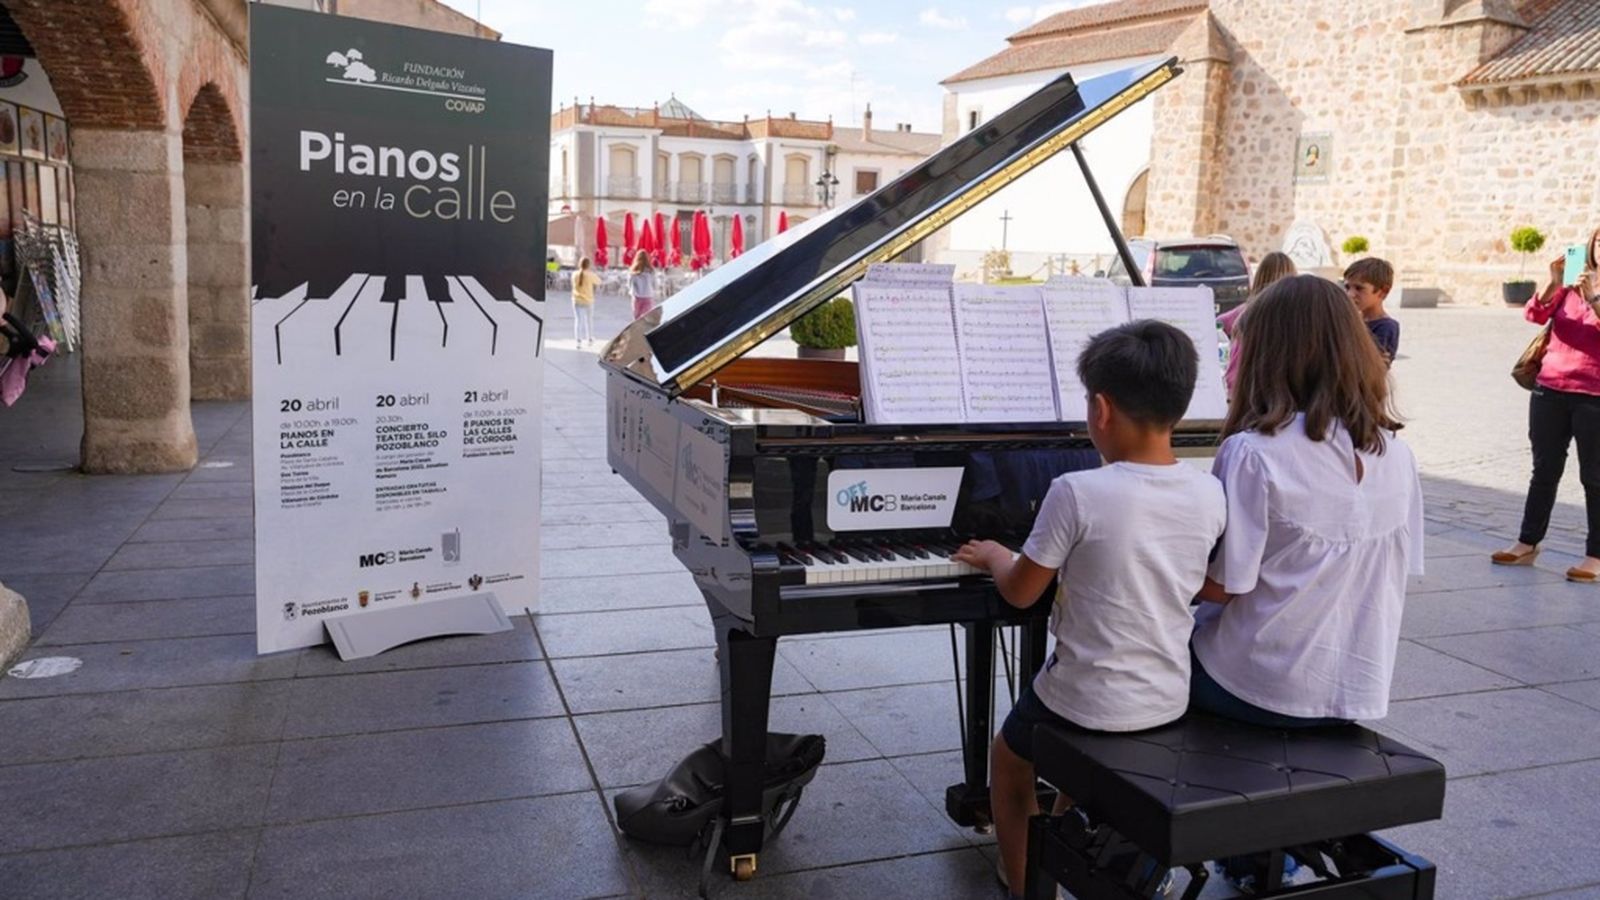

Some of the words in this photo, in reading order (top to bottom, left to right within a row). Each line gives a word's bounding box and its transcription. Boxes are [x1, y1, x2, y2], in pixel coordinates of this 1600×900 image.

[403, 62, 465, 79] FUNDACIÓN
[382, 72, 415, 85] Ricardo
[416, 77, 450, 91] Delgado
[445, 99, 486, 113] COVAP
[300, 130, 461, 182] Pianos
[332, 189, 366, 209] en
[374, 186, 396, 210] la
[403, 144, 517, 223] calle
[376, 394, 396, 408] 20
[399, 392, 430, 407] abril
[464, 391, 478, 403] 21
[481, 389, 509, 403] abril
[280, 399, 302, 412] 20
[306, 396, 340, 411] abril
[375, 423, 429, 434] CONCIERTO
[470, 418, 502, 427] PIANOS
[503, 418, 515, 426] EN
[280, 429, 319, 440] PIANOS
[321, 428, 335, 438] EN
[375, 432, 413, 443] TEATRO
[414, 431, 426, 440] EL
[427, 430, 448, 439] SILO
[464, 428, 479, 436] LAS
[481, 426, 512, 435] CALLES
[280, 441, 294, 449] LA
[296, 438, 329, 448] CALLE
[375, 439, 439, 451] POZOBLANCO
[464, 437, 475, 445] DE
[836, 480, 869, 507] OFF
[851, 494, 898, 513] MCB
[901, 494, 922, 502] Maria
[923, 493, 947, 501] Canals
[901, 503, 937, 511] Barcelona
[360, 551, 397, 568] MCB
[302, 604, 349, 616] Pozoblanco
